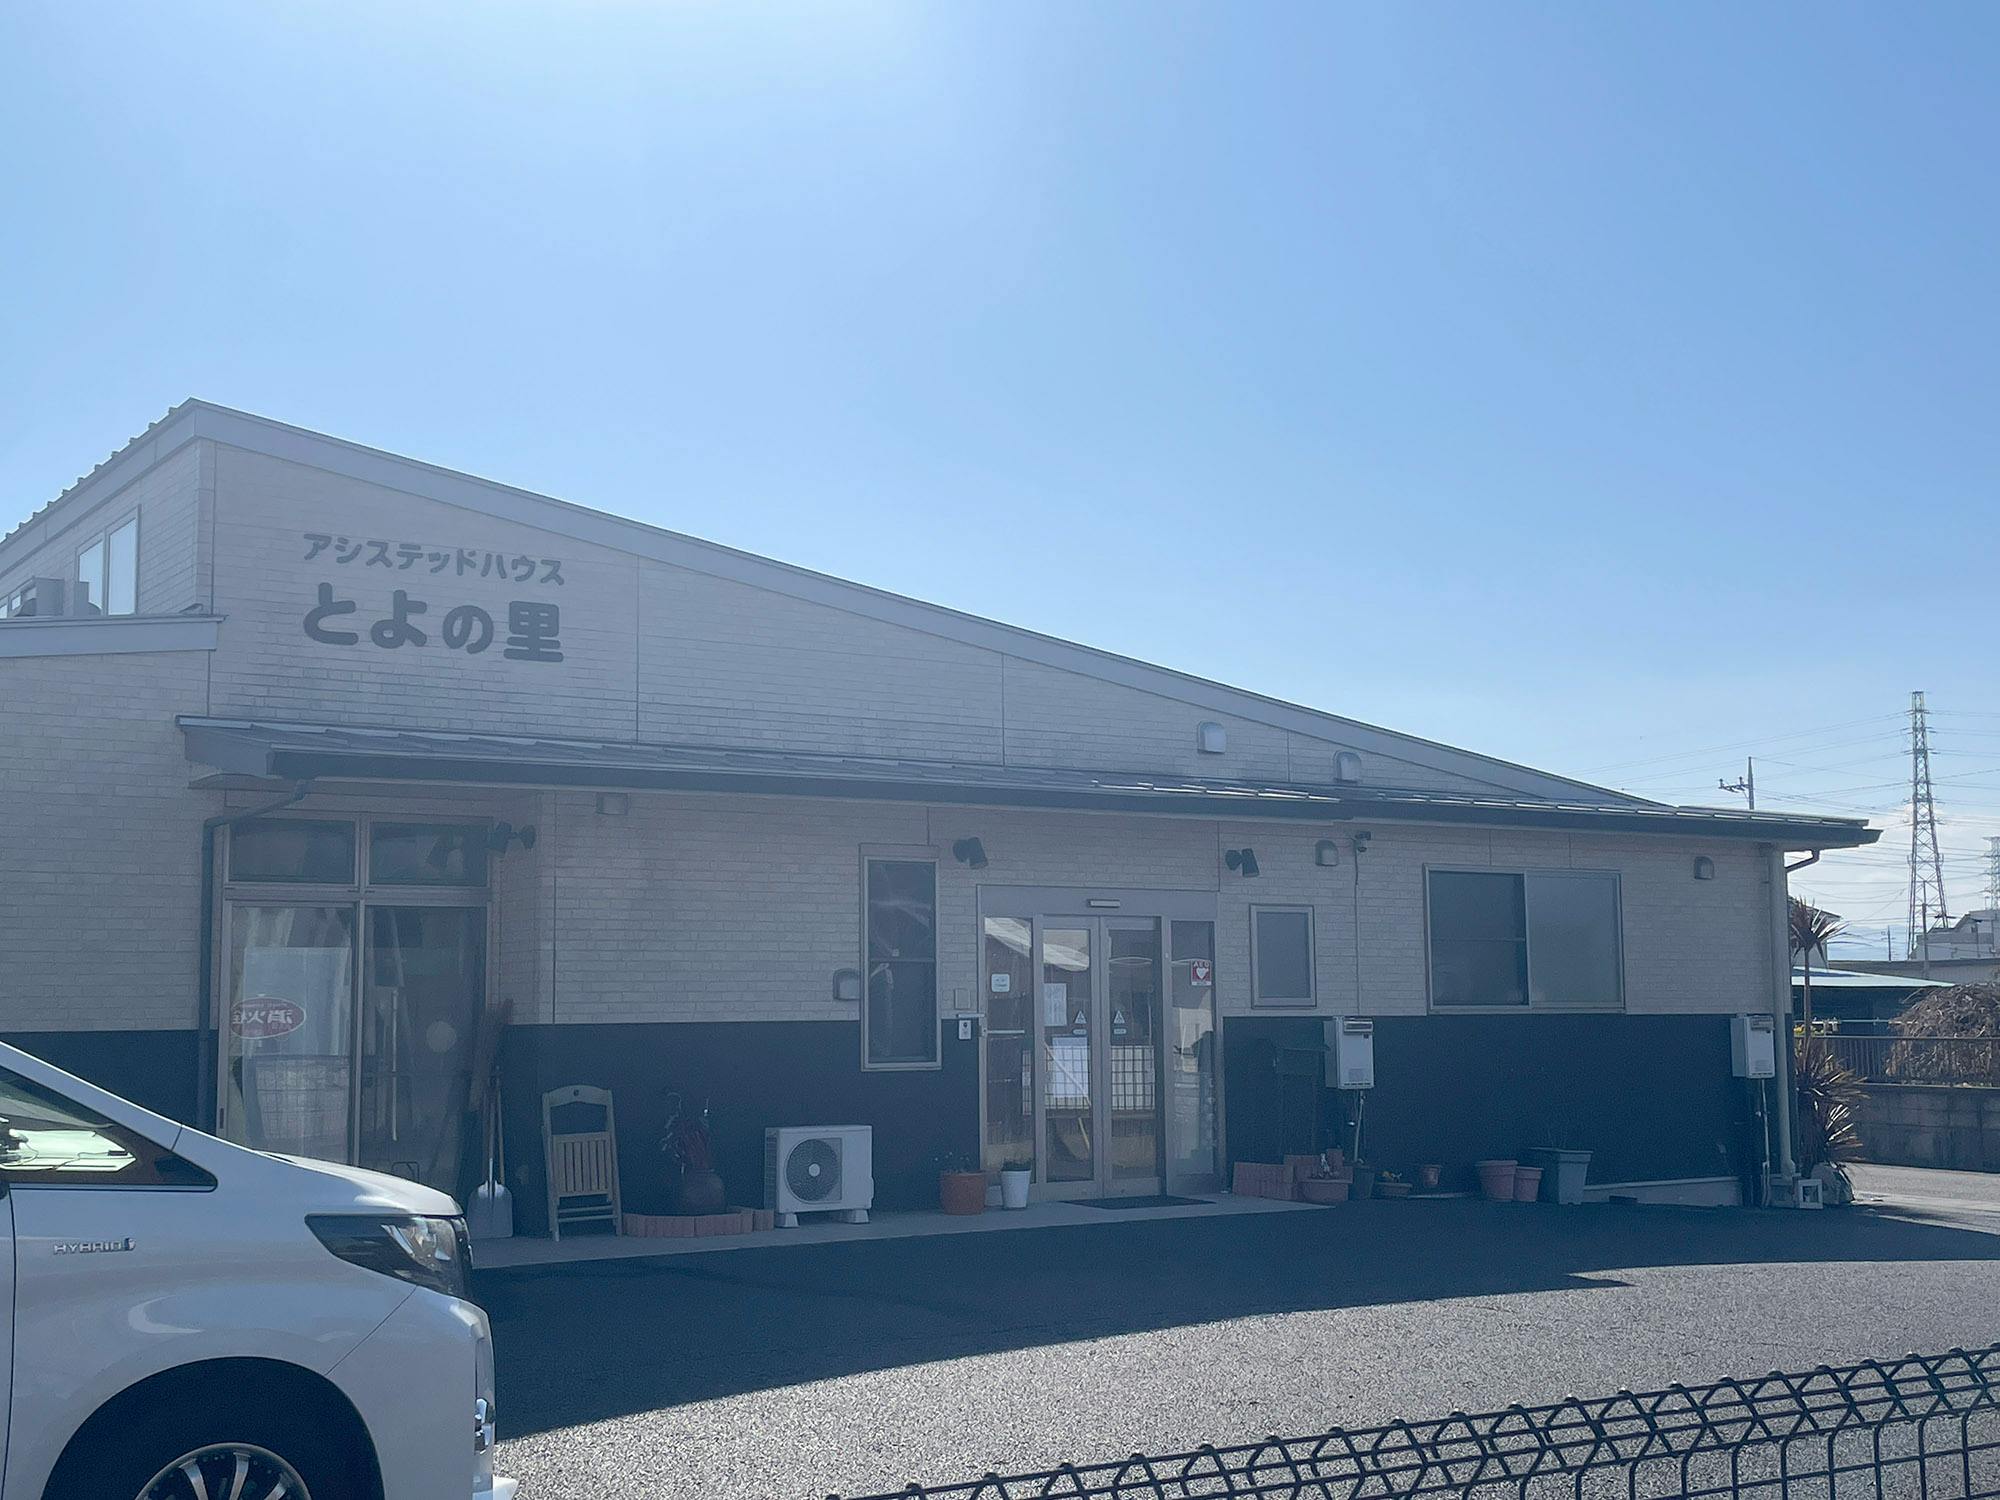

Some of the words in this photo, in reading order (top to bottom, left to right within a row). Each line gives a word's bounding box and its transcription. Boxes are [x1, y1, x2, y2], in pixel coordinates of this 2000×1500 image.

[303, 533, 565, 586] アシステッドハウス
[303, 582, 565, 662] とよの里
[53, 1241, 122, 1255] HYBRID
